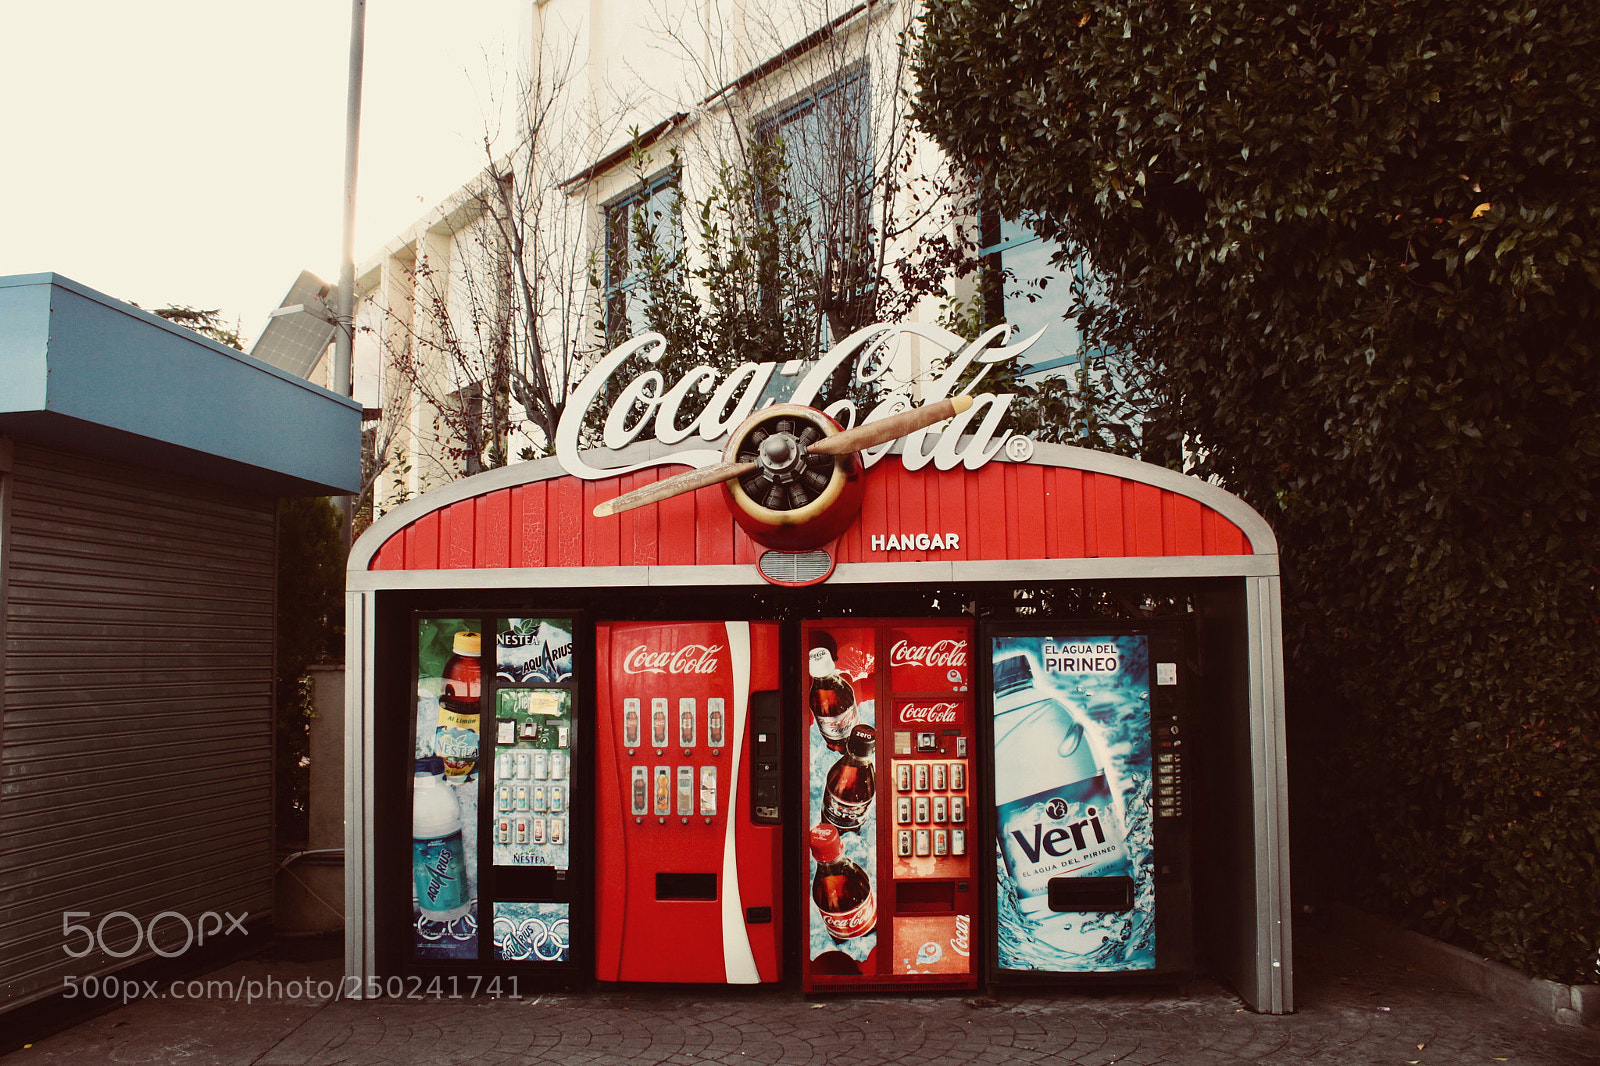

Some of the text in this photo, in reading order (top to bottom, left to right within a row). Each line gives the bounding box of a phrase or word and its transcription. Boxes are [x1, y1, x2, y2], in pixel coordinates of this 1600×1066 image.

[871, 533, 960, 551] HANGAR
[496, 633, 539, 646] NESTEA
[1045, 645, 1118, 654] EL AGUA DEL
[522, 639, 573, 676] AQUARIUS
[623, 644, 724, 675] Coca-Cola
[890, 639, 968, 667] Coca-Cola
[1046, 657, 1117, 672] PIRINEO
[899, 702, 959, 723] Coca-Cola
[856, 731, 872, 740] zero
[1010, 807, 1106, 864] Veri
[513, 854, 546, 864] NESTEA
[1034, 864, 1058, 876] AGUA
[1061, 857, 1081, 868] DEL
[1083, 845, 1116, 861] PIRINEO
[426, 848, 457, 903] AQUARIUS
[502, 925, 534, 961] AQUARIUS
